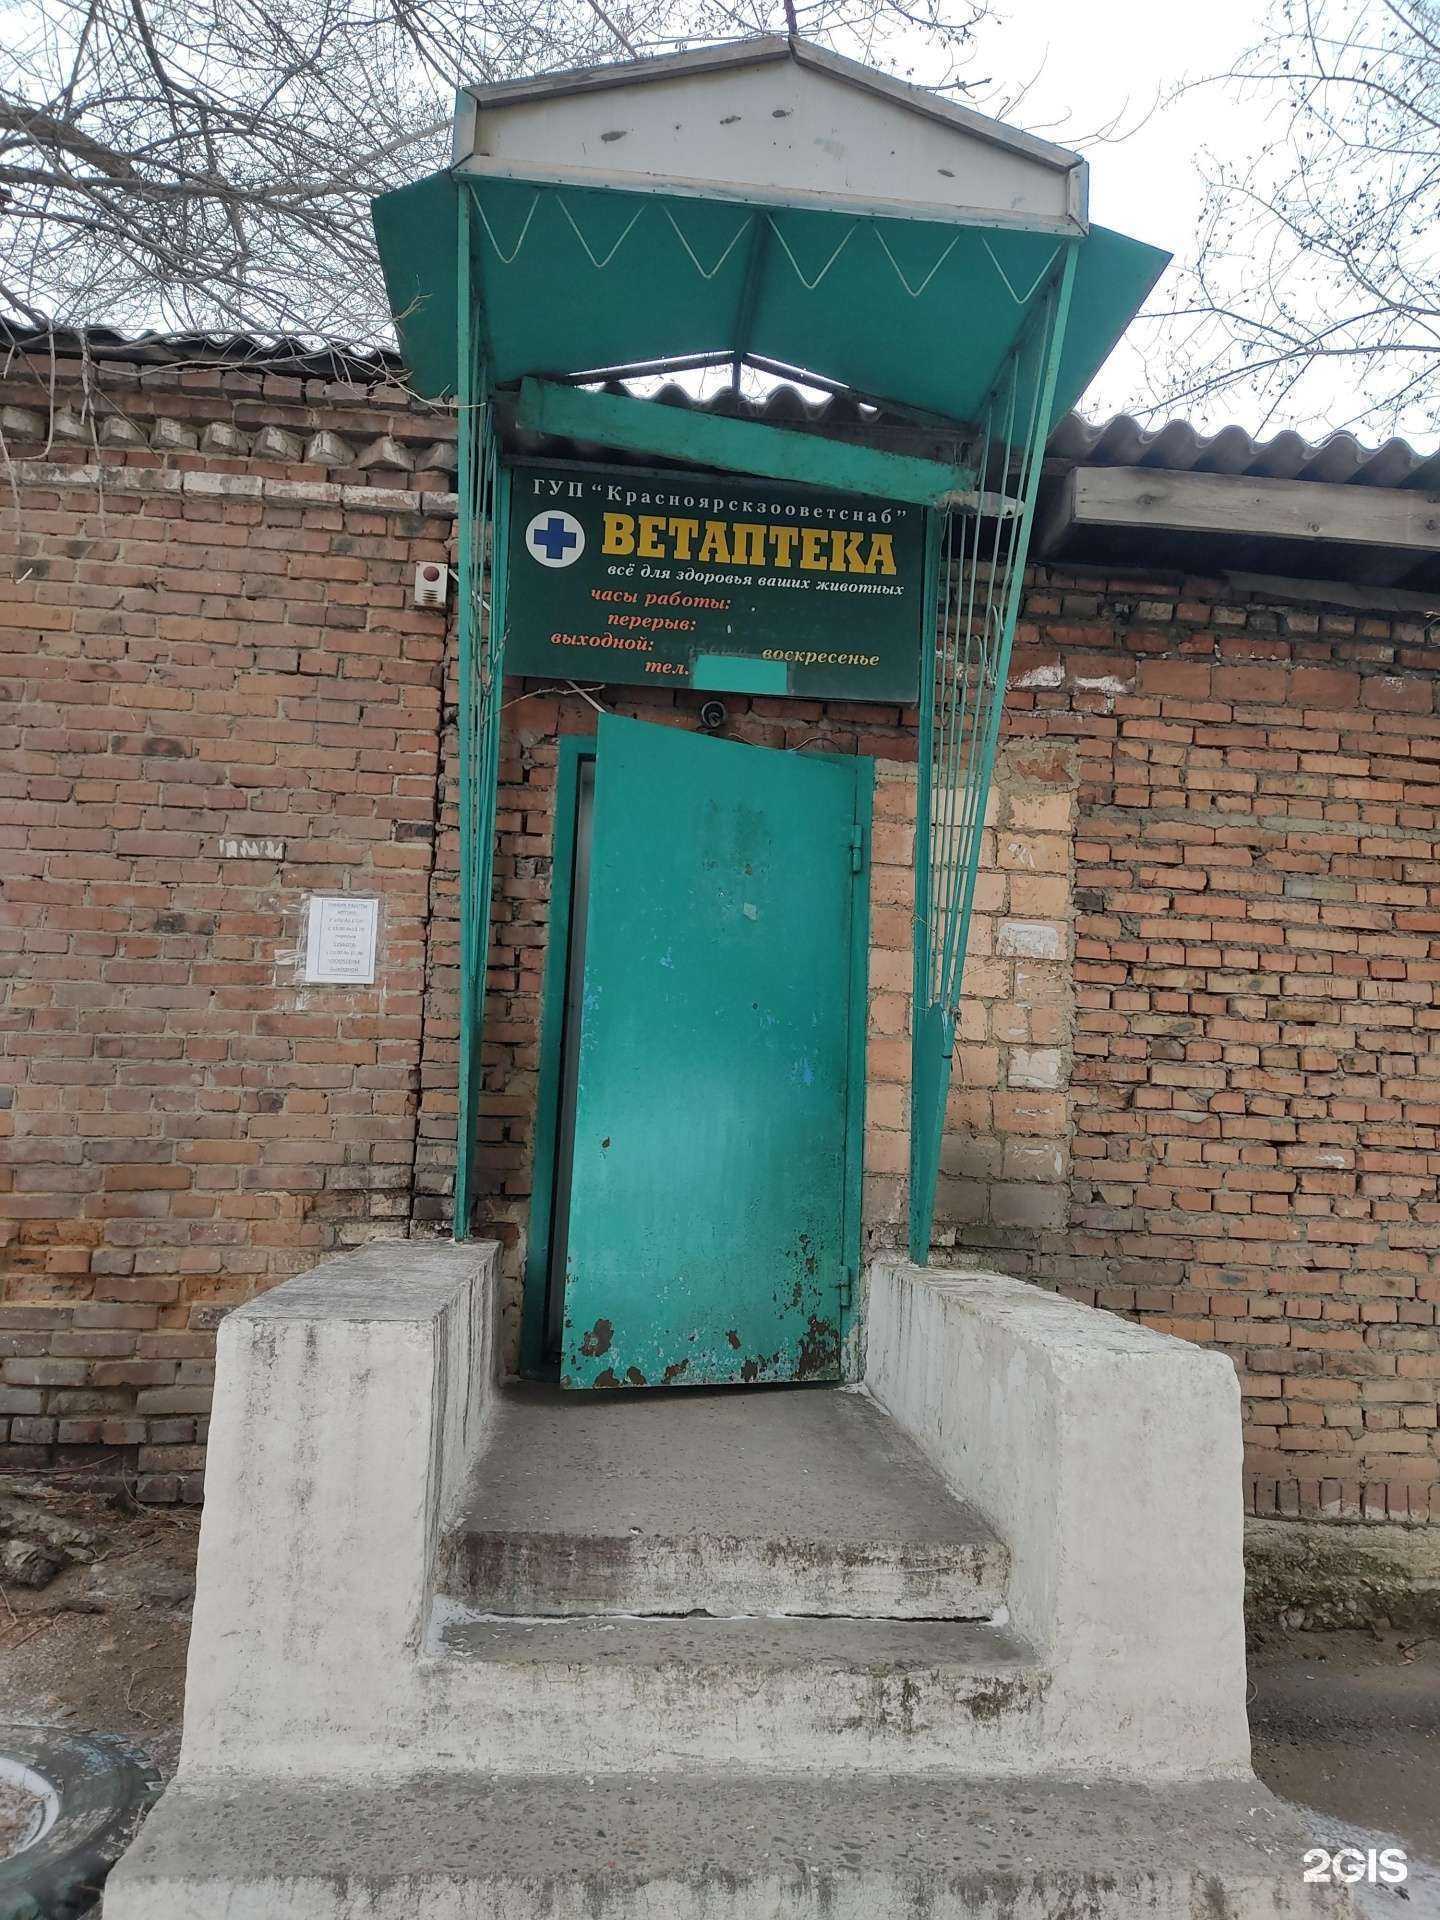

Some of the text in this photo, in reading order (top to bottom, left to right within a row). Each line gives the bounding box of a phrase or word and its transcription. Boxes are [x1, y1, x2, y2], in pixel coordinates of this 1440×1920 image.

[533, 478, 584, 498] ГУП
[601, 511, 897, 575] ВЕТАПТЕКА
[607, 563, 905, 596] всё для здоровья ваших животных
[591, 588, 731, 610] часы работы:
[607, 614, 697, 631] перерыв:
[550, 632, 654, 651] выходной:
[762, 648, 880, 667] воскресенье
[644, 661, 689, 676] тел.
